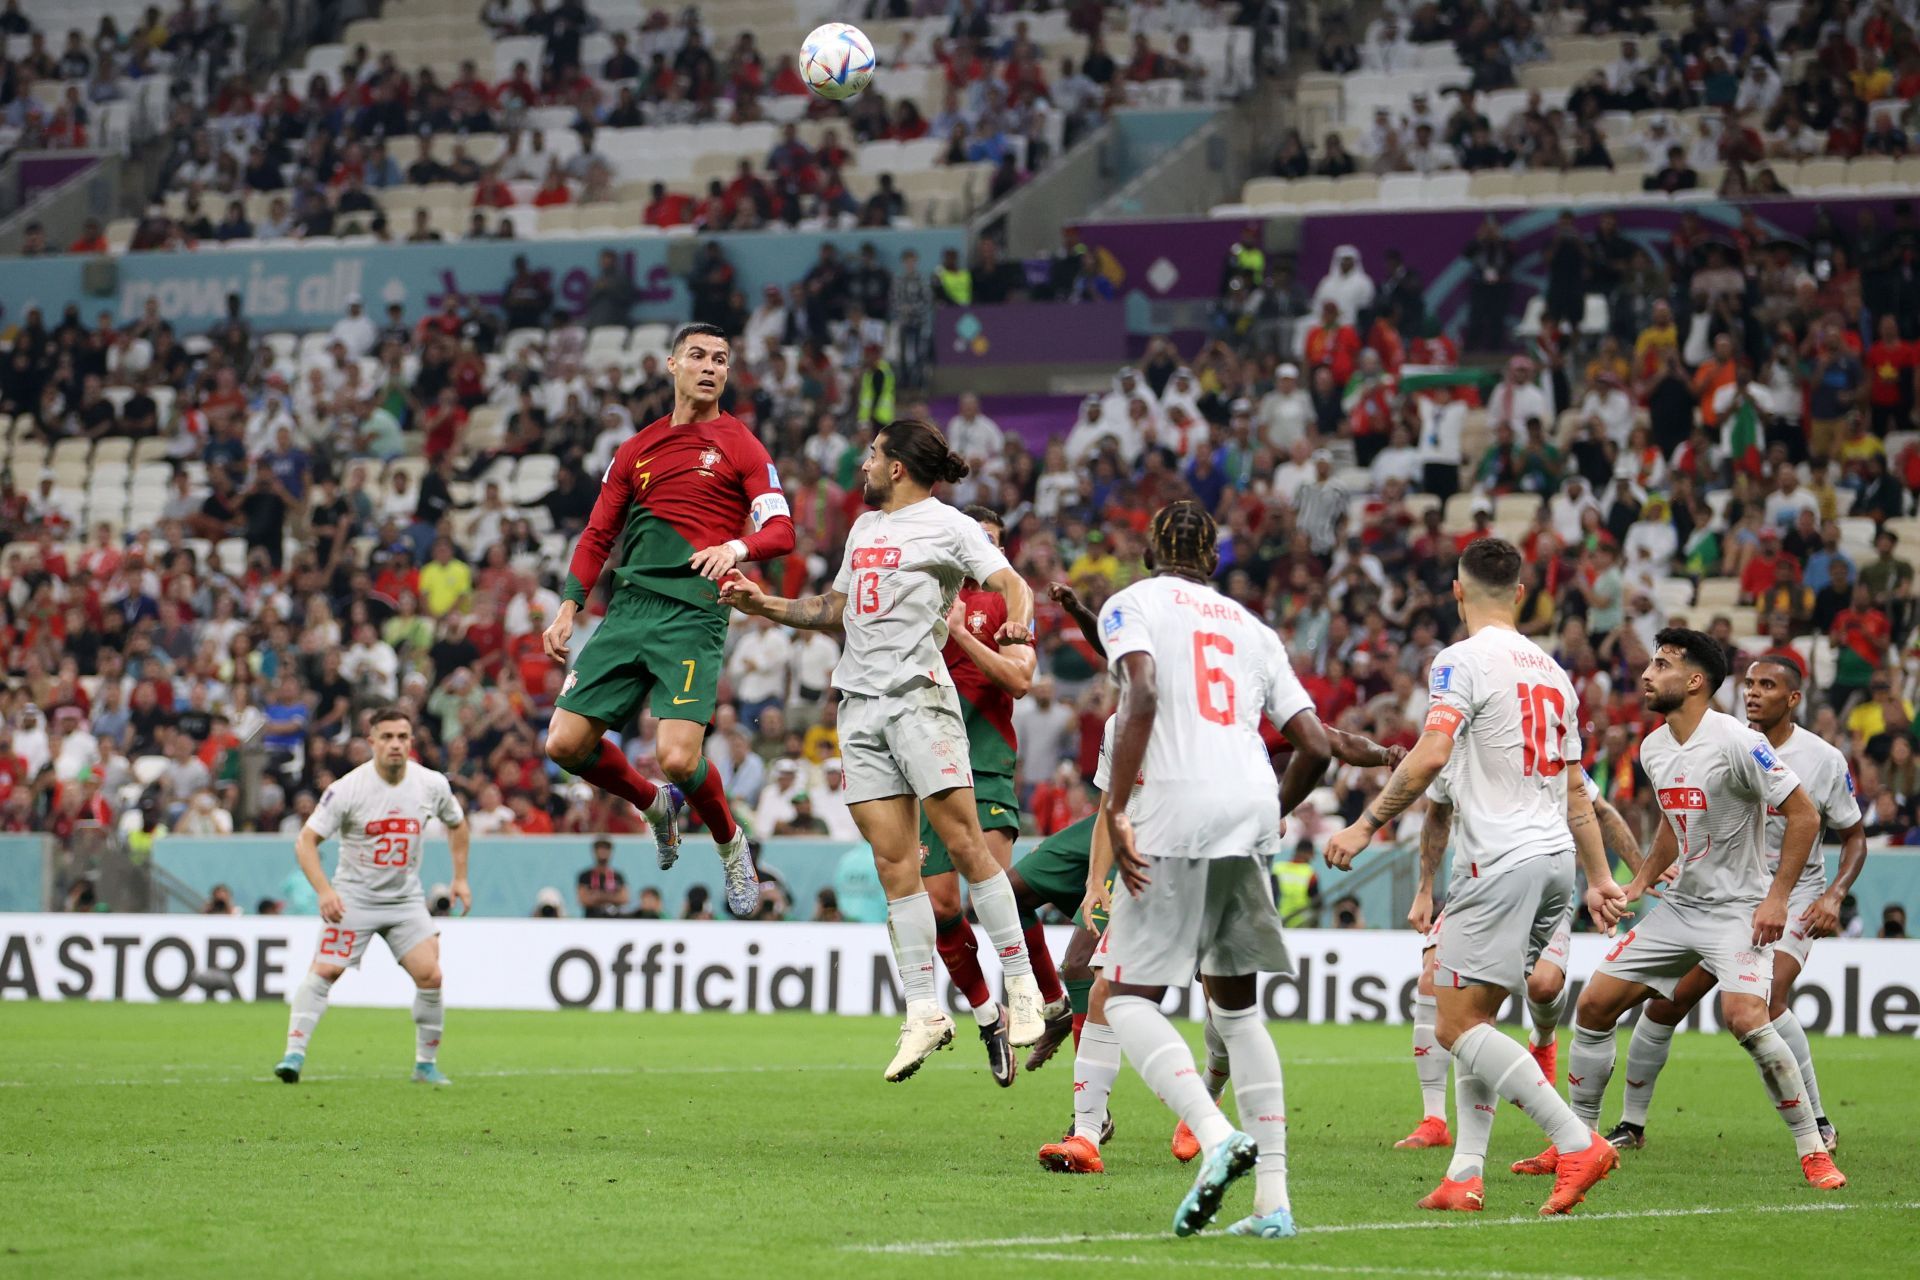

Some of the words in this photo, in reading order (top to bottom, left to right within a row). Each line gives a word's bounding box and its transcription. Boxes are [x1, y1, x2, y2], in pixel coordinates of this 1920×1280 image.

[245, 261, 290, 316] is
[298, 258, 365, 314] all
[640, 472, 651, 491] 7
[856, 571, 879, 615] 13
[682, 660, 696, 692] 7
[1194, 631, 1235, 726] 6
[1517, 682, 1566, 777] 10
[373, 837, 409, 867] 23
[321, 927, 357, 958] 23
[56, 935, 288, 998] STORE
[550, 942, 839, 1010] Official
